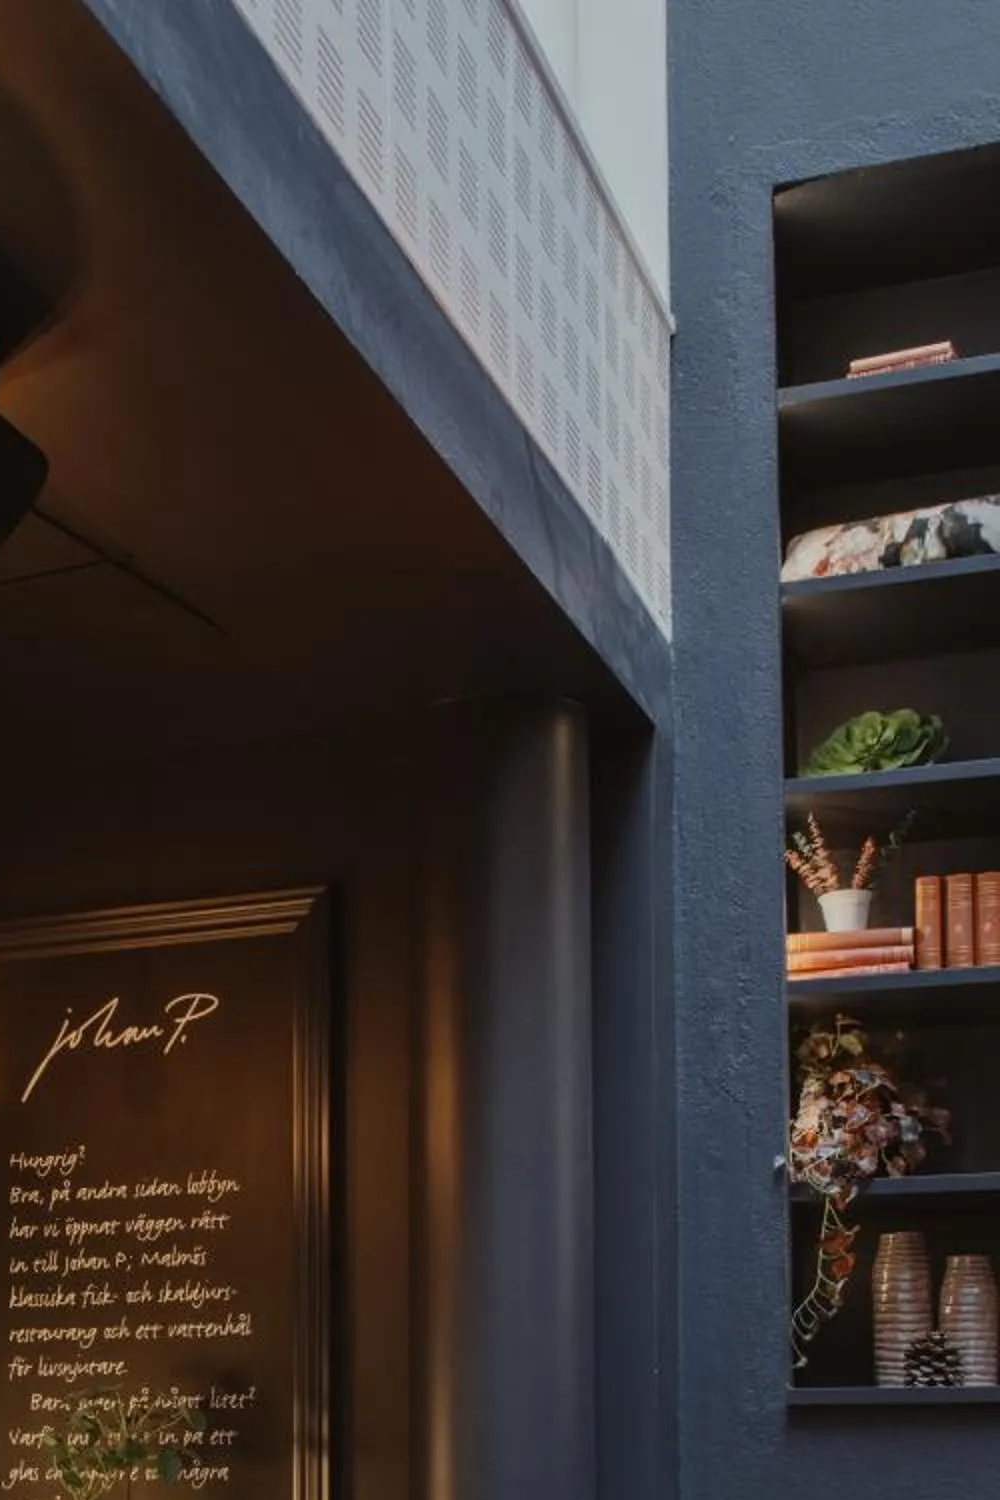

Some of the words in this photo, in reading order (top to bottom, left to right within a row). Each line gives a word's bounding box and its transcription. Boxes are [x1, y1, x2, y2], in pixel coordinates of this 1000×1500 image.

[20, 995, 164, 1103] johan
[9, 1144, 86, 1177] Hungrig?
[49, 1180, 71, 1211] på
[75, 1180, 128, 1201] andra
[133, 1177, 183, 1198] sidan
[187, 1169, 240, 1202] lobbyn
[9, 1216, 39, 1239] har
[43, 1218, 61, 1237] vi
[65, 1216, 120, 1245] öppnat
[125, 1213, 185, 1240] väggen
[190, 1210, 232, 1231] rätt
[9, 1255, 29, 1273] in
[33, 1250, 58, 1272] till
[141, 1244, 208, 1266] Malmös
[9, 1285, 76, 1308] klassiska
[126, 1281, 153, 1303] och
[9, 1325, 98, 1349] restaurang
[103, 1316, 130, 1339] och
[135, 1320, 164, 1339] ett
[168, 1313, 253, 1338] vattenhål
[8, 1355, 33, 1380] för
[37, 1354, 128, 1383] livsnjutare
[210, 1429, 239, 1445] ett
[1, 1460, 39, 1490] glas
[178, 1459, 230, 1489] några
